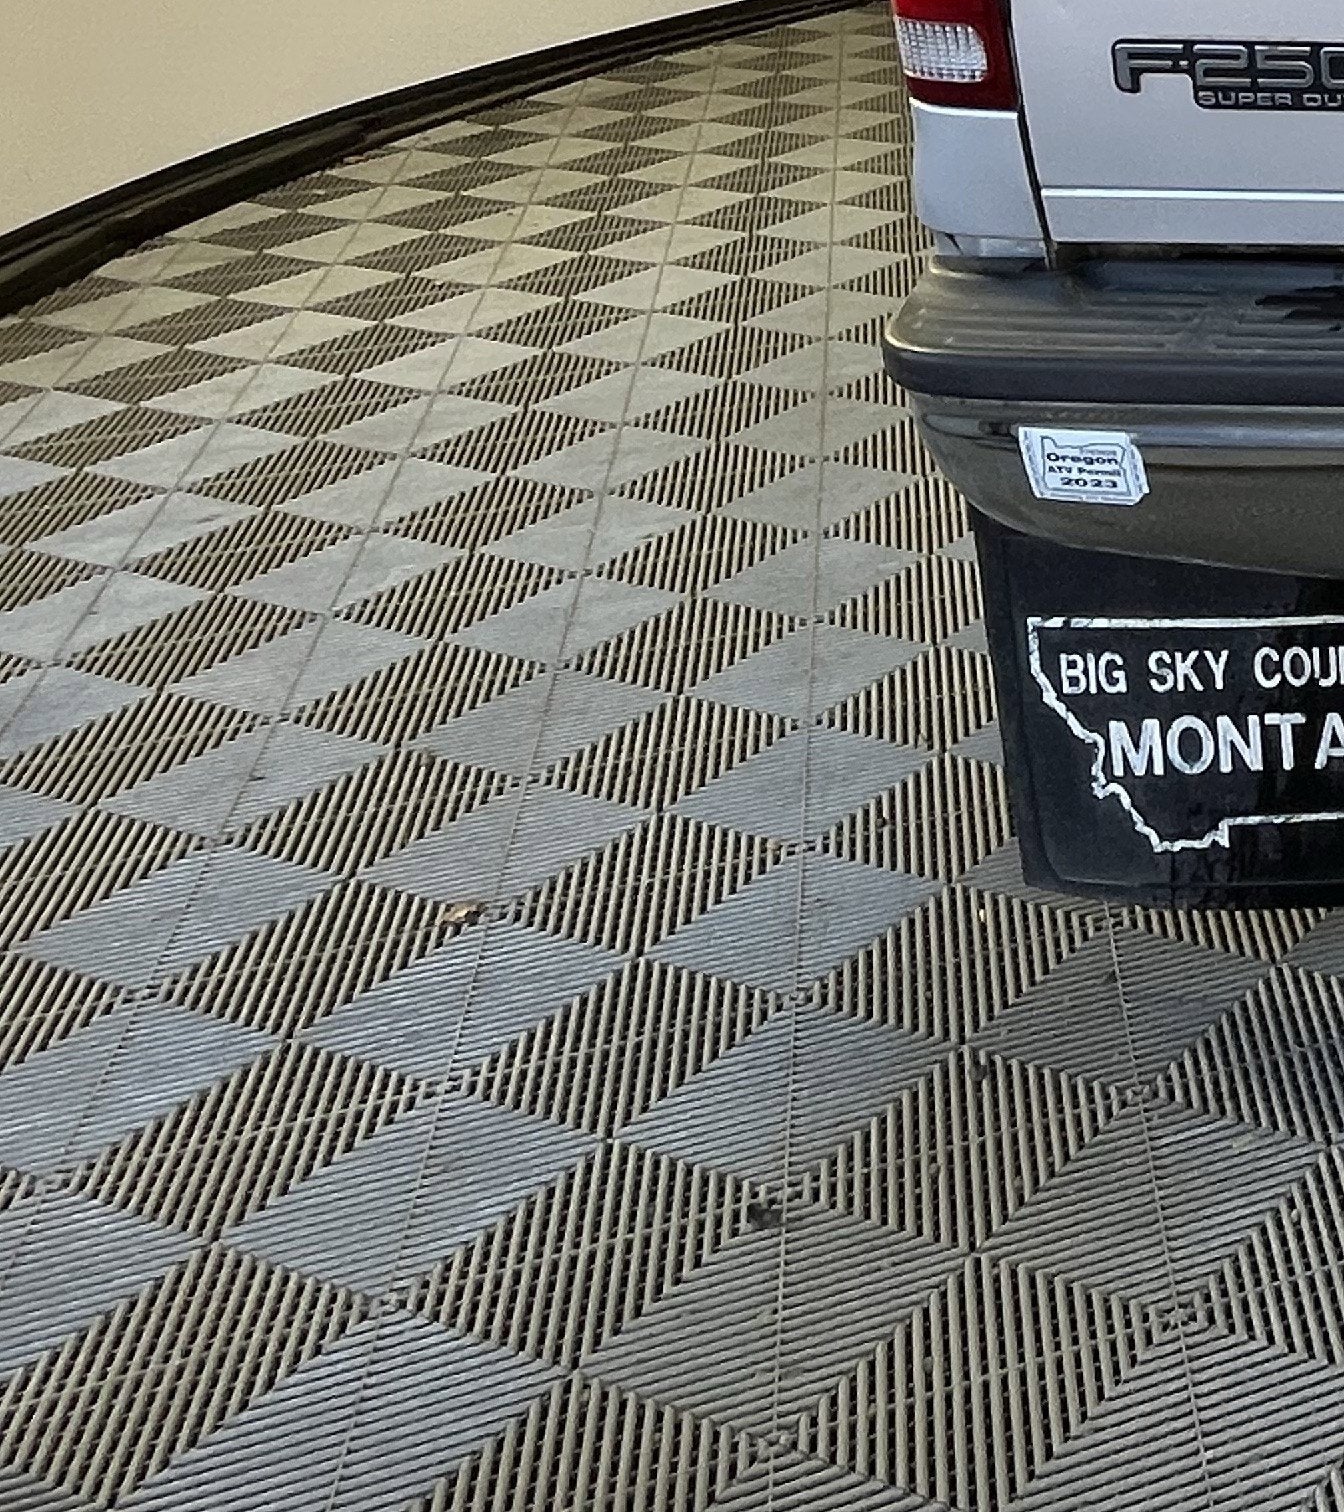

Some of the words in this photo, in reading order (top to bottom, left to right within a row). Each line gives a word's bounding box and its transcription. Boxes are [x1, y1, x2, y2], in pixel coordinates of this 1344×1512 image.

[1197, 91, 1293, 107] SUPER
[1046, 452, 1119, 465] Oregon
[1059, 652, 1129, 695] BIG
[1147, 649, 1230, 692] SKY
